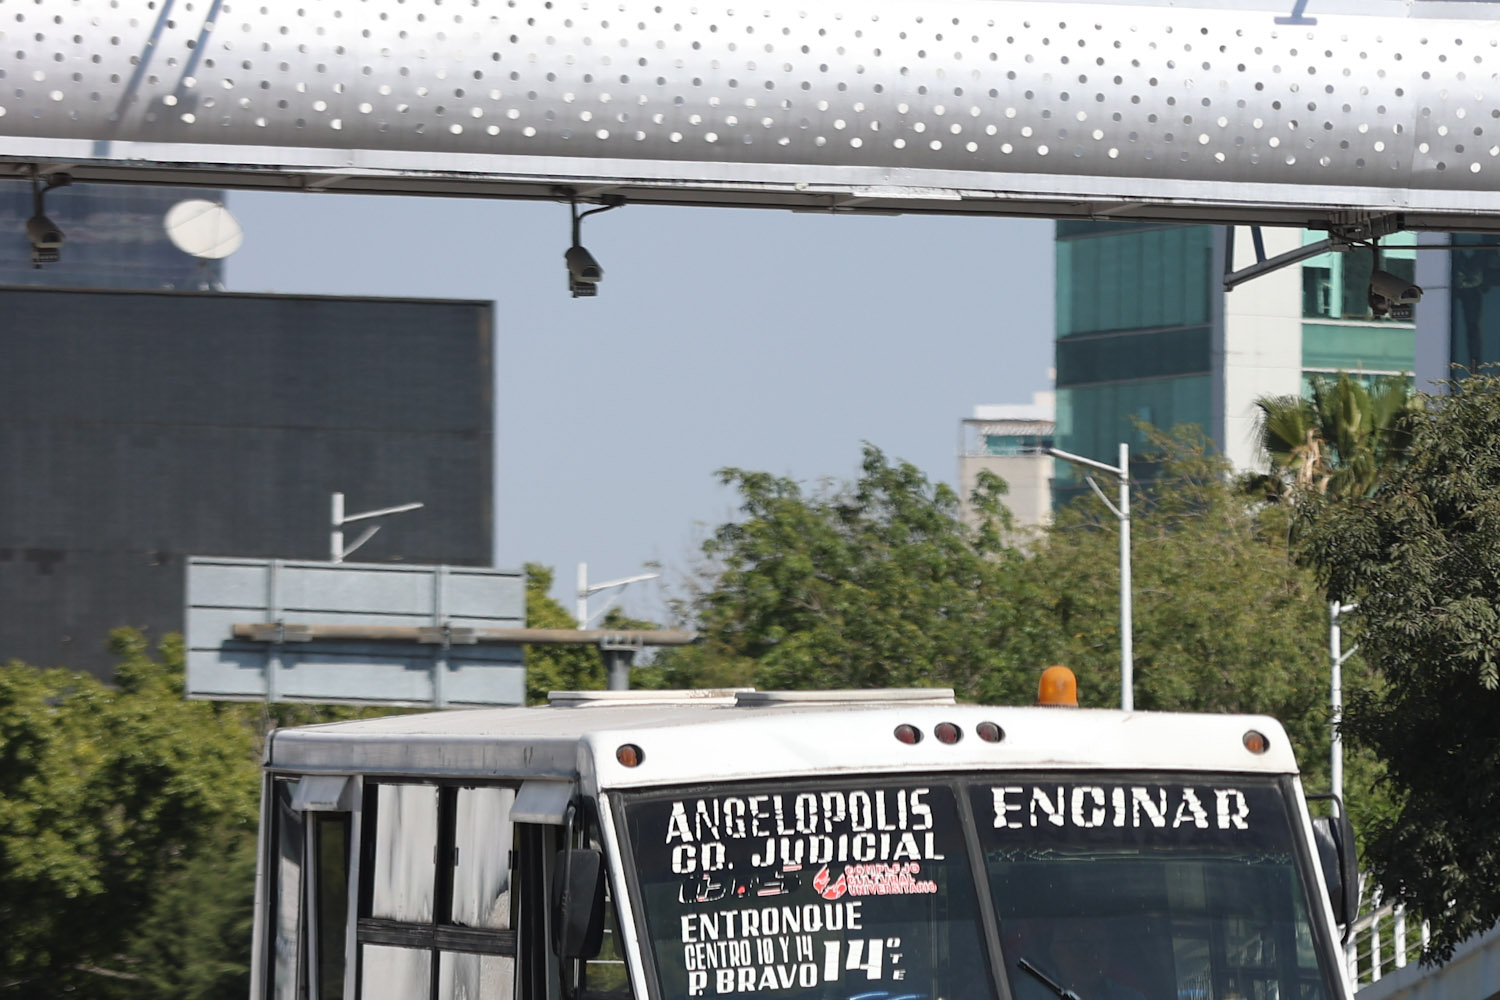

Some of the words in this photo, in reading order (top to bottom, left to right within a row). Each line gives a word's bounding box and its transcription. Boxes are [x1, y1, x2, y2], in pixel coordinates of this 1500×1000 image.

[666, 788, 934, 844] ANGELOPOLIS
[991, 786, 1250, 830] ENCINAR
[672, 842, 734, 874] CD.
[751, 832, 945, 867] JUDICIAL
[844, 862, 920, 875] COMPLEJO
[848, 881, 938, 896] UNIVERSITARIO
[681, 901, 863, 943] ENTRONQUE
[684, 938, 752, 971] CENTRO
[757, 937, 775, 964] 10
[778, 935, 790, 963] Y
[796, 934, 814, 962] 14
[823, 938, 884, 982] 14
[716, 962, 818, 995] BRAVO
